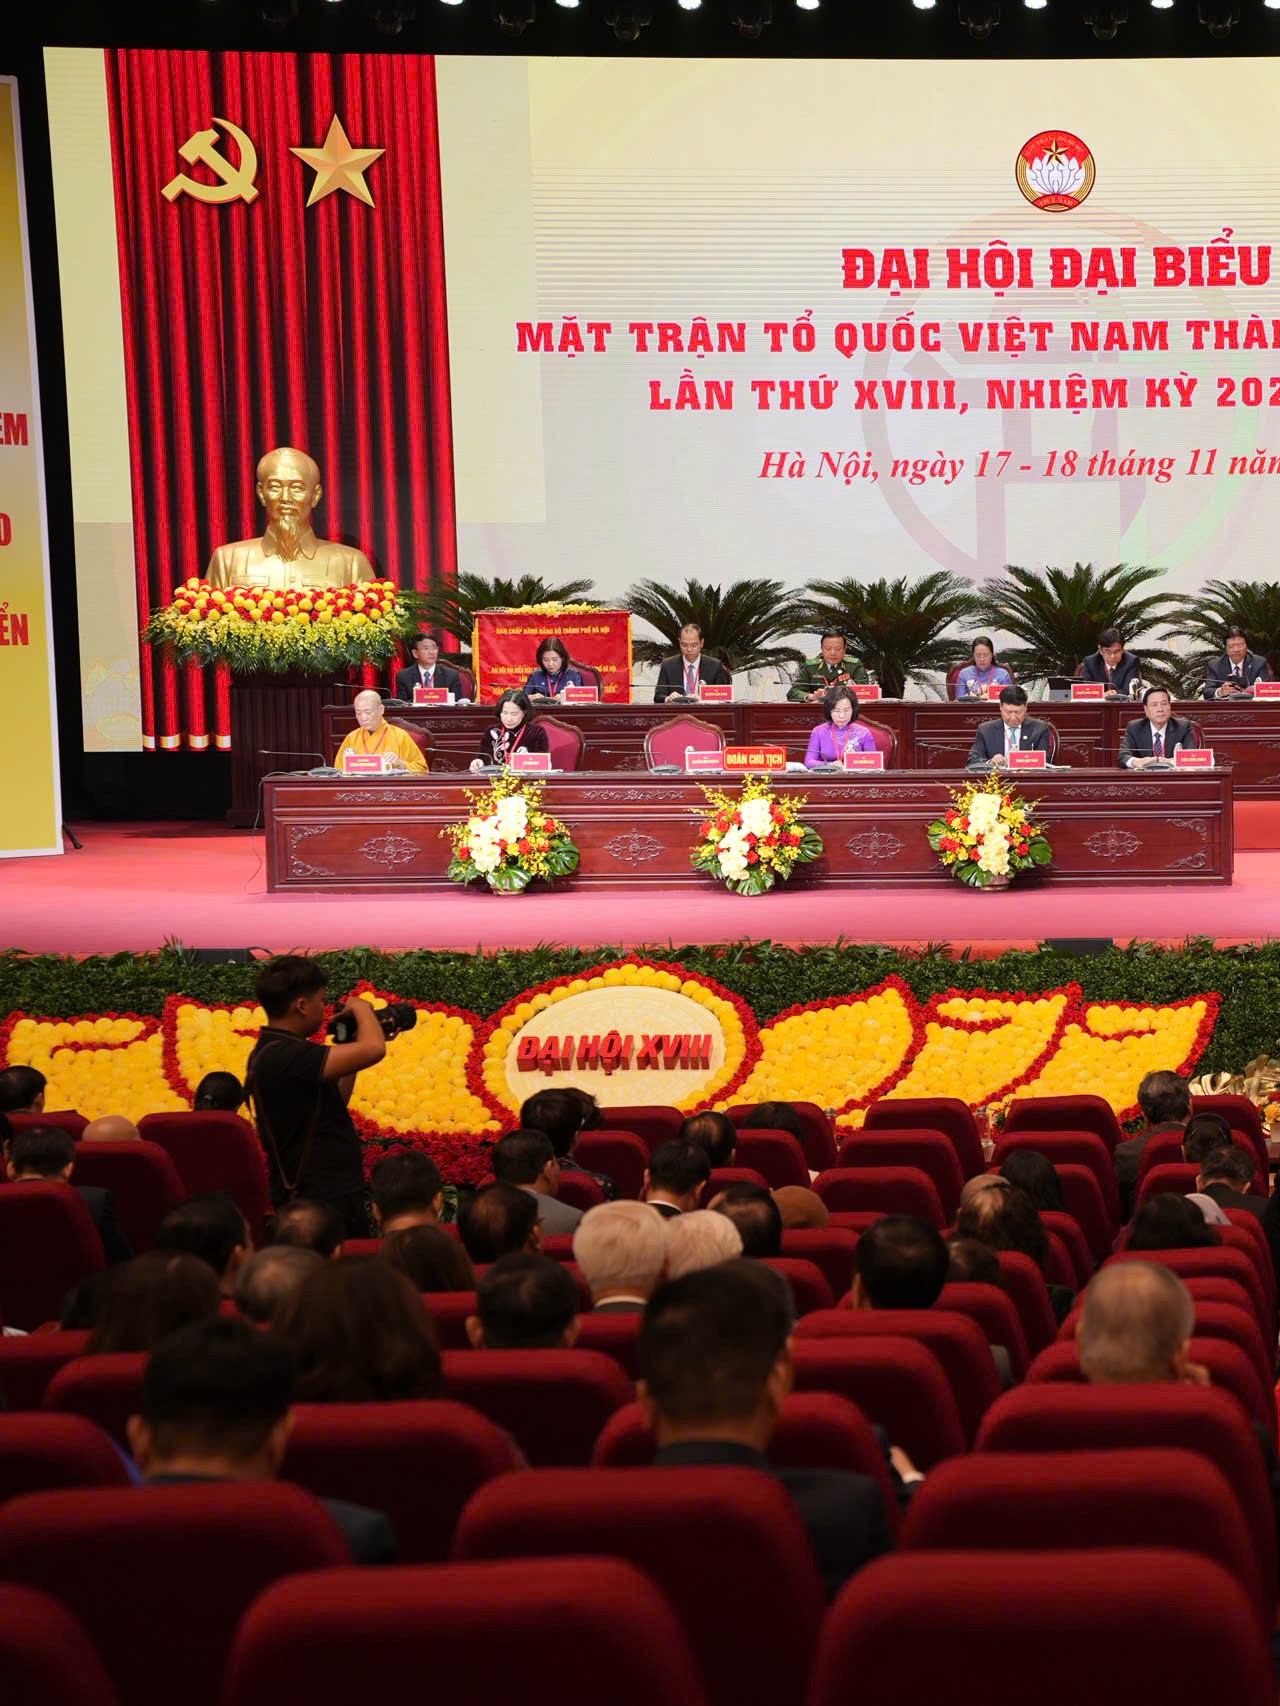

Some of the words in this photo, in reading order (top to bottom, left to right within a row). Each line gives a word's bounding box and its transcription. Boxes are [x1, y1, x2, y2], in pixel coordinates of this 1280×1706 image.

[841, 247, 931, 297] ĐẠI
[945, 239, 1035, 298] HỘI
[1049, 246, 1138, 297] ĐẠI
[1153, 226, 1273, 288] BIỂU
[515, 315, 613, 359] MẶT
[628, 315, 747, 359] TRẬN
[763, 308, 817, 353] TỔ
[834, 310, 943, 359] QUỐC
[958, 315, 1055, 359] VIỆT
[1070, 320, 1170, 352] NAM
[648, 367, 735, 411] LẦN
[751, 373, 840, 411] THỨ
[854, 379, 969, 415] XVIII,
[985, 372, 1129, 415] NHIỆM
[1145, 371, 1199, 409] KỲ
[0, 412, 29, 446] M
[758, 451, 806, 479] Hà
[816, 451, 880, 486] Nội,
[890, 451, 966, 485] ngày
[975, 450, 1013, 477] 17
[1043, 449, 1079, 477] 18
[1087, 448, 1176, 483] tháng
[1185, 448, 1218, 475] 11
[726, 752, 748, 765] ĐOÀN
[749, 750, 764, 765] CHỦ
[766, 753, 783, 767] TỊCH
[516, 1035, 575, 1076] ĐẠI
[577, 1029, 634, 1076] HỘI
[637, 1034, 712, 1070] XVIII
